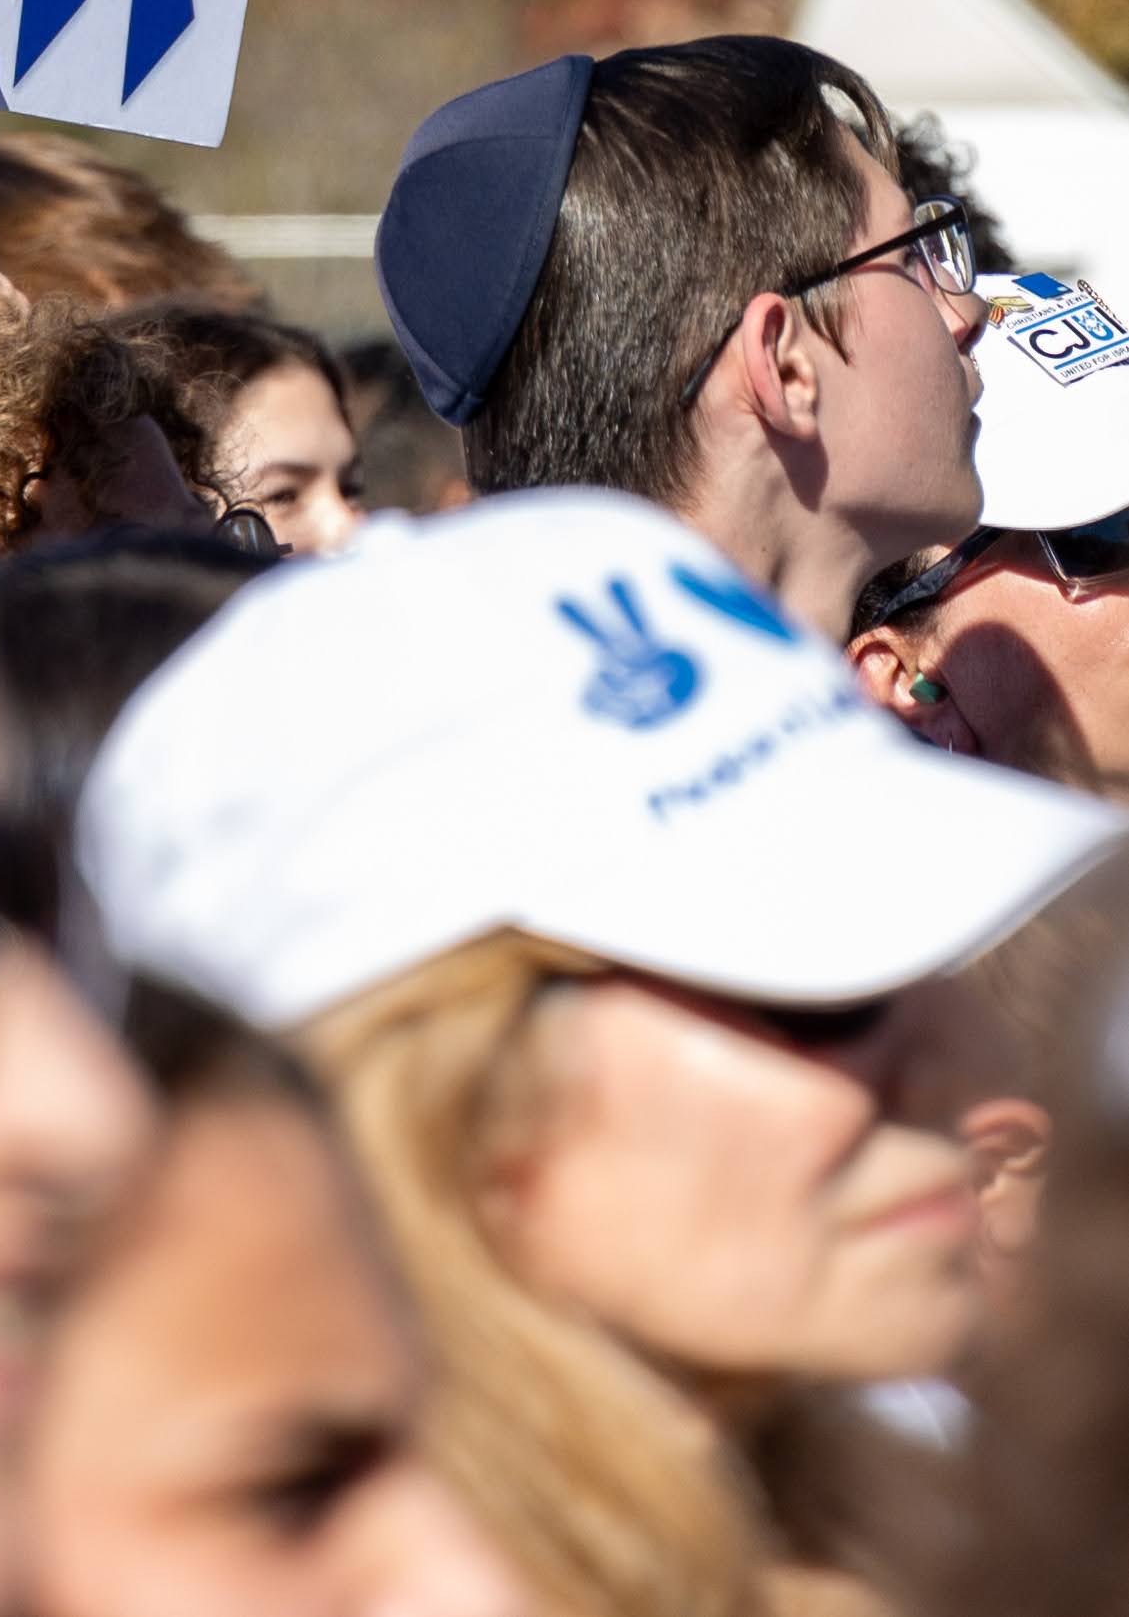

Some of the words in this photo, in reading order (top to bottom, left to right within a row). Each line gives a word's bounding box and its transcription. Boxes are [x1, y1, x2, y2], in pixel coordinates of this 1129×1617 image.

[1006, 306, 1056, 329] CHRISTIANS
[1065, 294, 1089, 306] JEWS
[1060, 362, 1092, 379] UNITED
[1092, 353, 1111, 365] FOR
